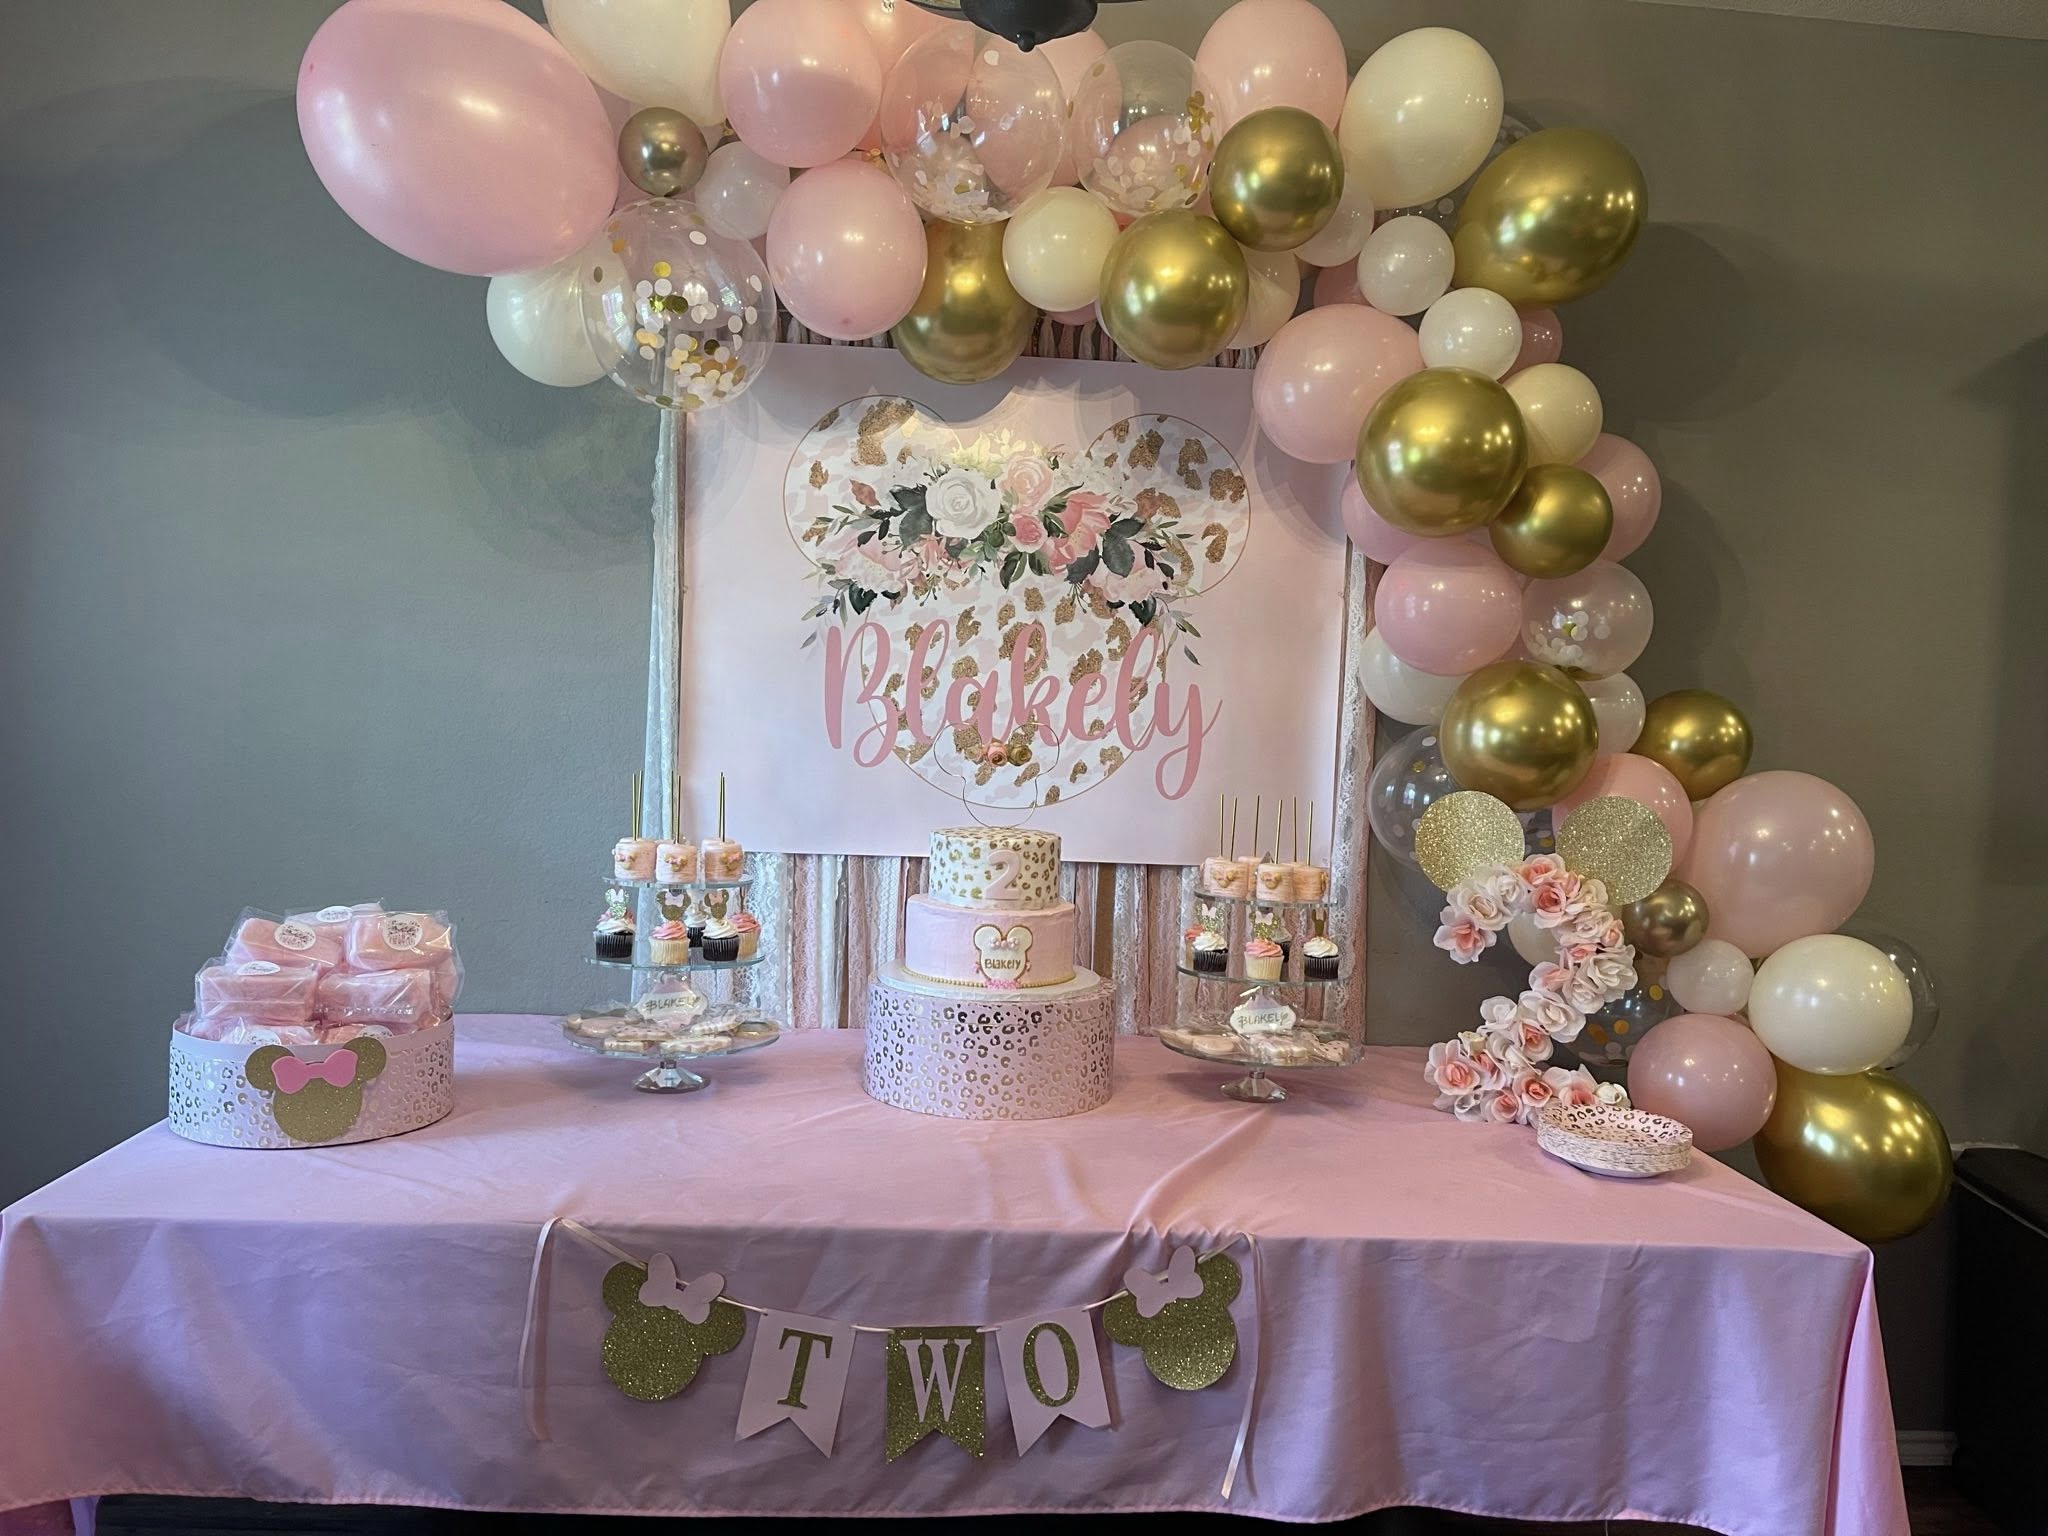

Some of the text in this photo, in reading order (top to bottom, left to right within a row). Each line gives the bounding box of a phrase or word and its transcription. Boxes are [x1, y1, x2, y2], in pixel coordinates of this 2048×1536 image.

[824, 618, 1223, 800] Blakely
[985, 849, 1022, 900] 2
[984, 958, 1021, 970] Blakely
[1238, 1011, 1289, 1029] BLAKELY
[777, 1321, 1081, 1423] TWO
